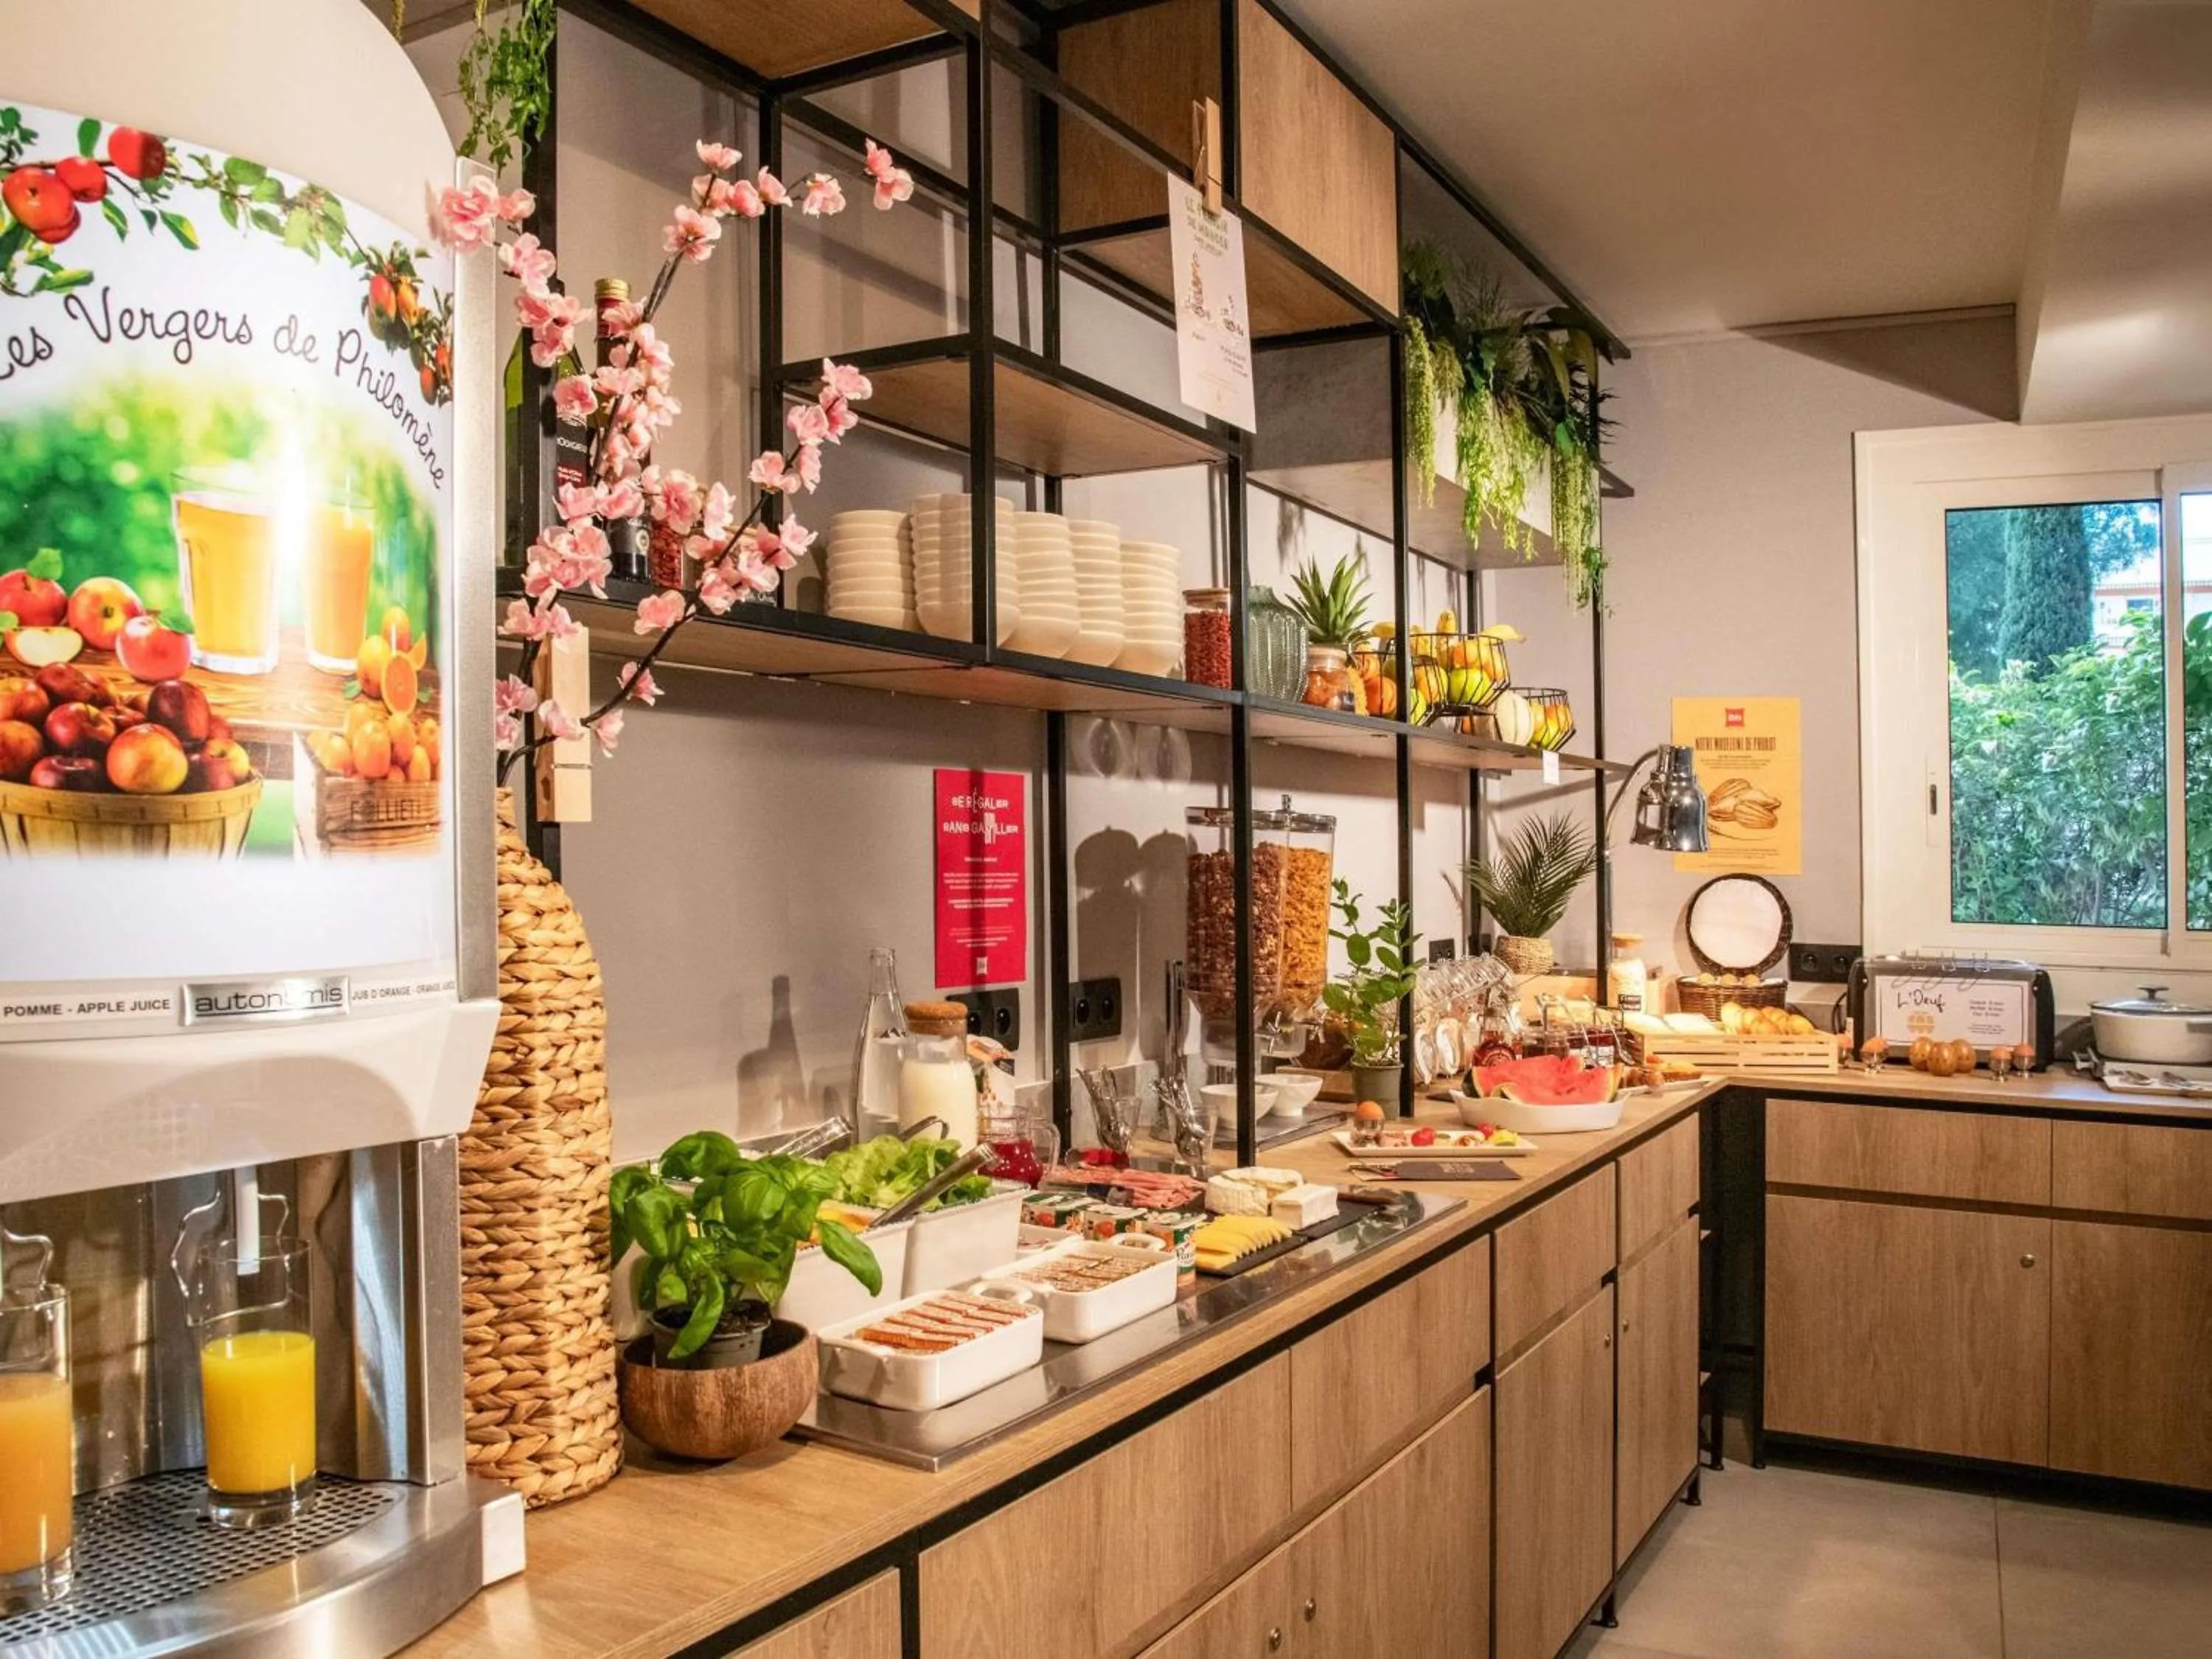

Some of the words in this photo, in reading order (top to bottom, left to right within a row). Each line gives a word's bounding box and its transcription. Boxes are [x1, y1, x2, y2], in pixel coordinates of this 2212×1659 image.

[63, 285, 253, 365] Vergers
[273, 314, 319, 363] de
[335, 327, 445, 490] Philomène
[195, 984, 343, 1012] autonmis
[352, 989, 369, 1001] JUS
[4, 1004, 62, 1017] POMME
[77, 1001, 125, 1015] APPLE
[129, 998, 171, 1012] JUICE
